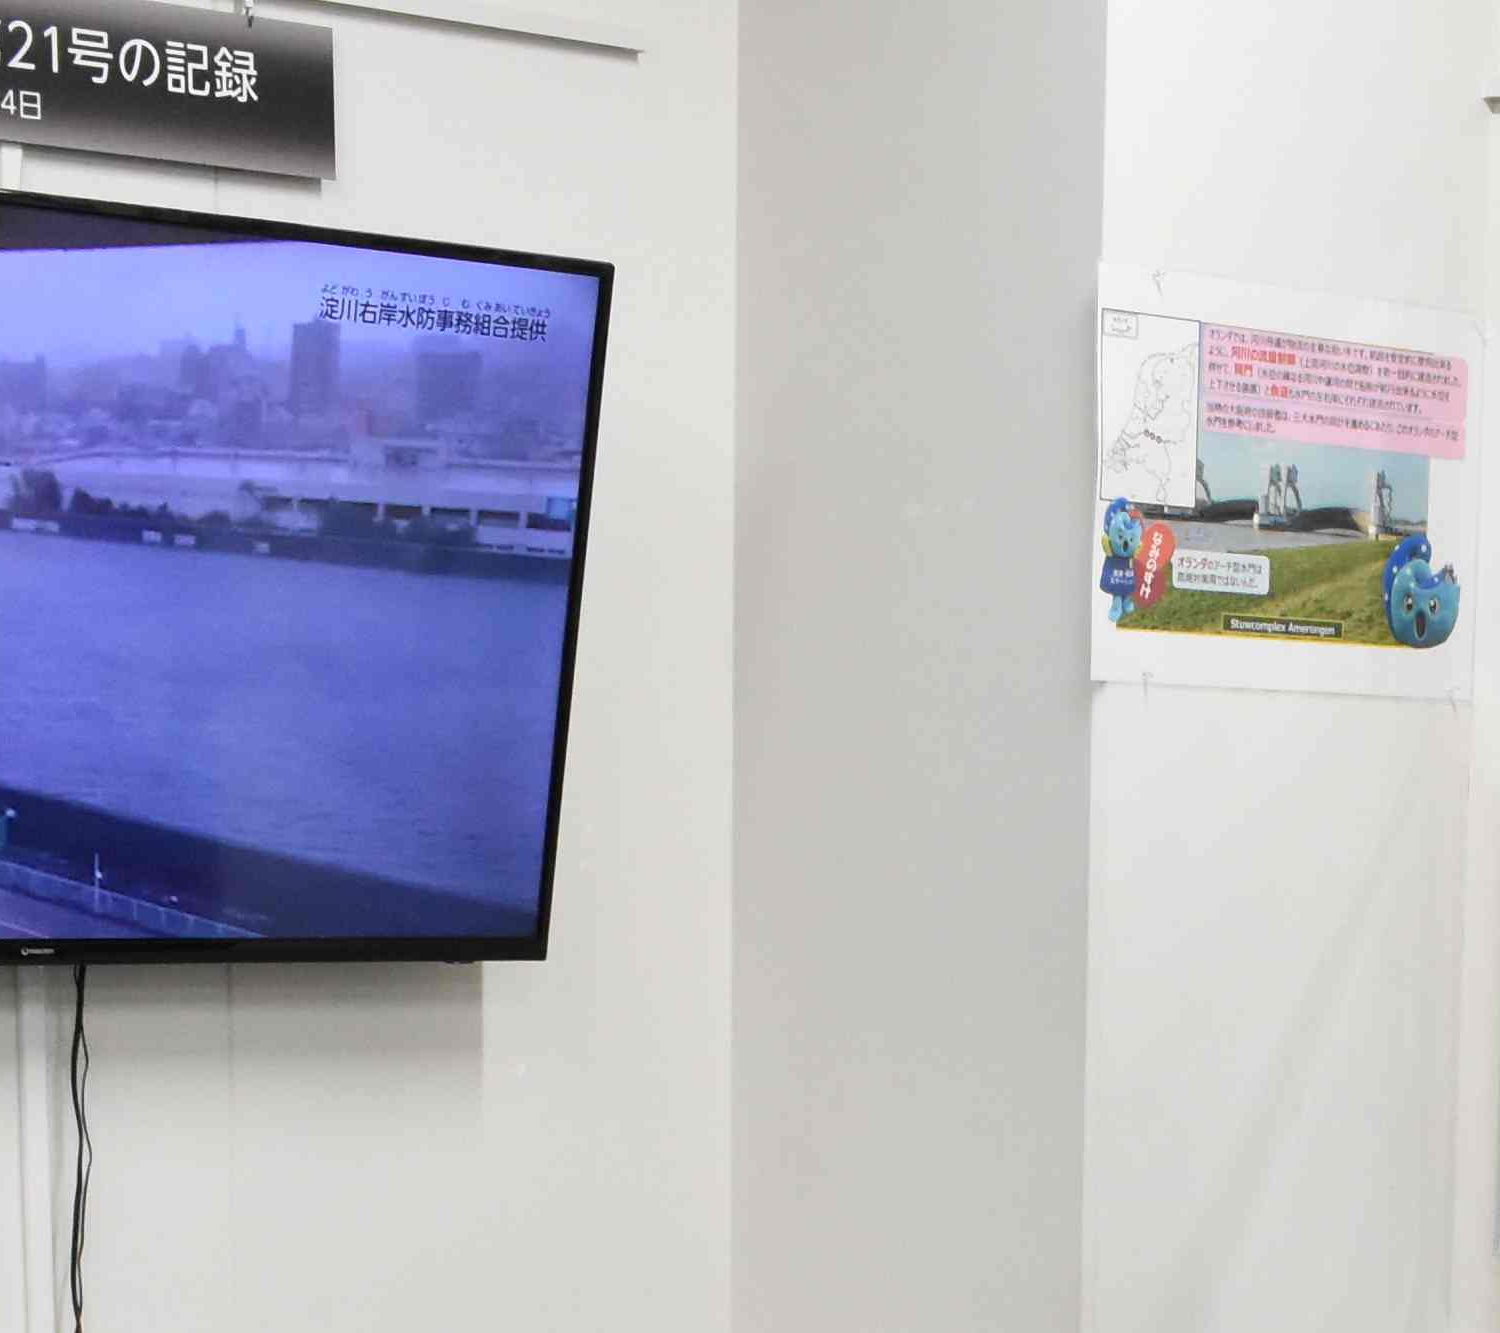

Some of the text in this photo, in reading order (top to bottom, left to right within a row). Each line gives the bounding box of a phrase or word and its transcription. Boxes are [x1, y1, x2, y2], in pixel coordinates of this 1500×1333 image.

[319, 296, 548, 343] 淀川右岸水防事務組合提供
